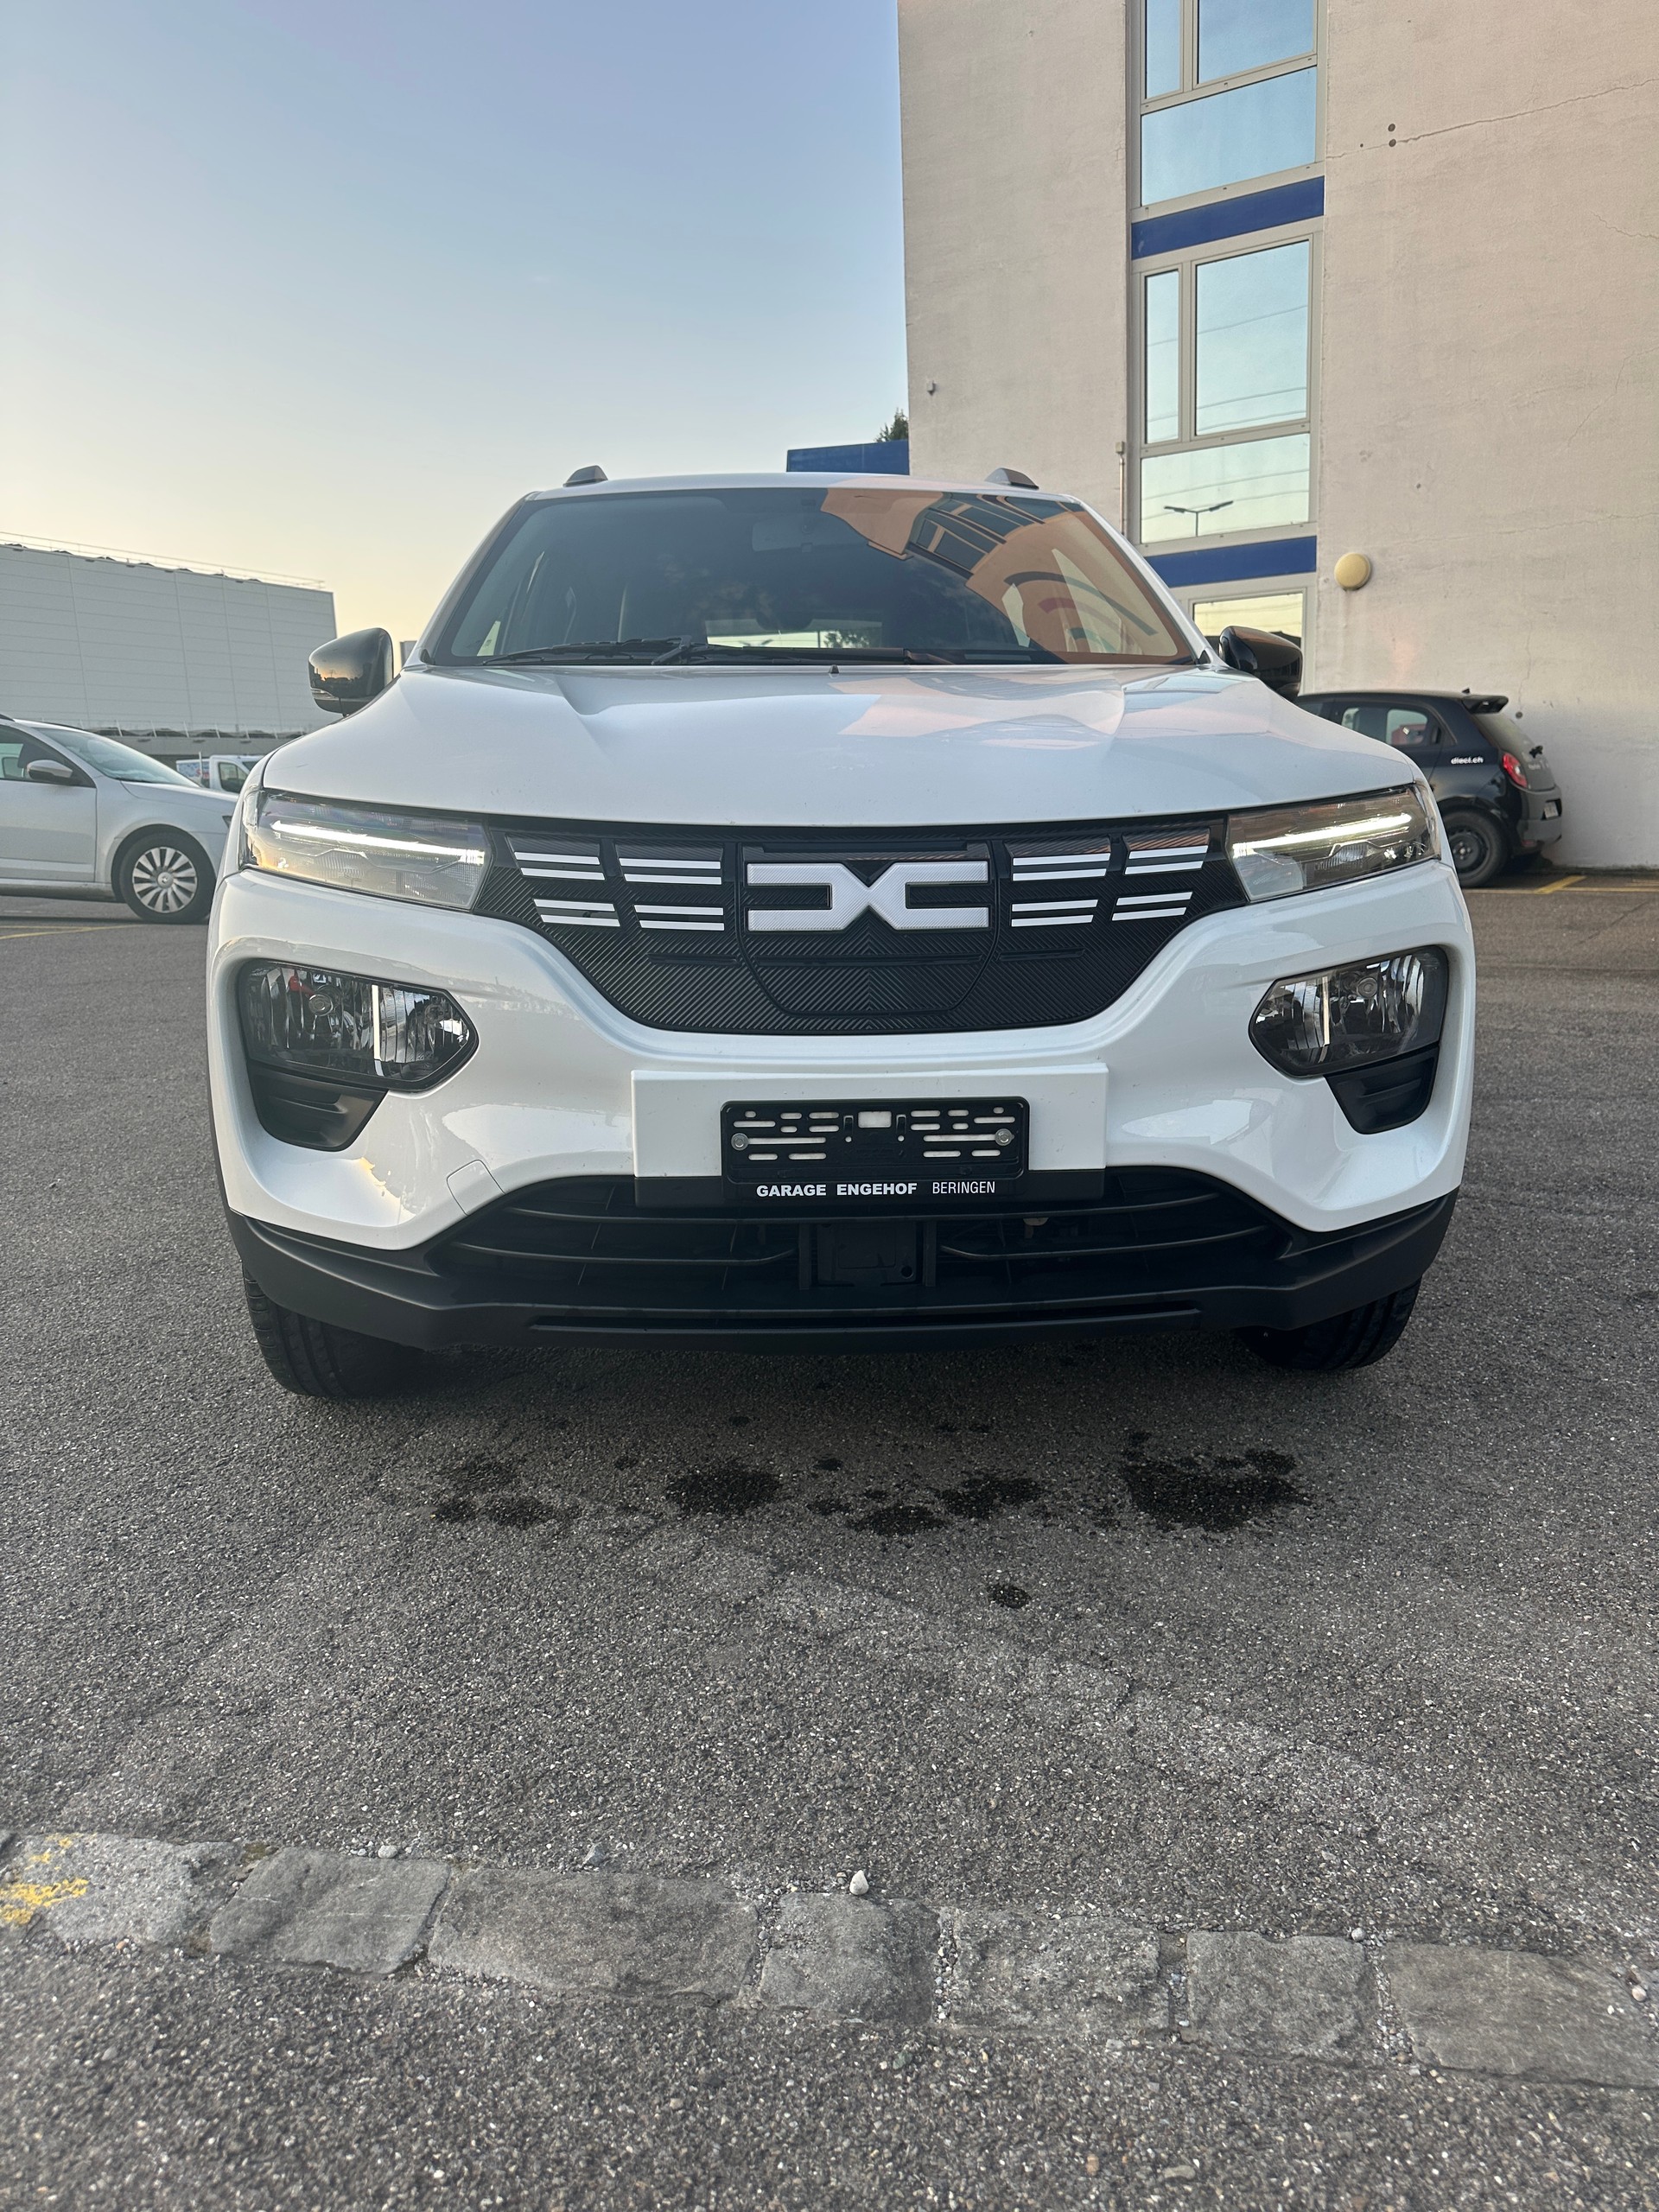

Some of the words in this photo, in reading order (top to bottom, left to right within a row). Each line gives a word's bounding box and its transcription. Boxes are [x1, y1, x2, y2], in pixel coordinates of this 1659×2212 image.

[755, 1184, 827, 1198] GARAGE
[836, 1182, 918, 1196] ENGEHOF
[932, 1180, 995, 1194] BERINGEN
